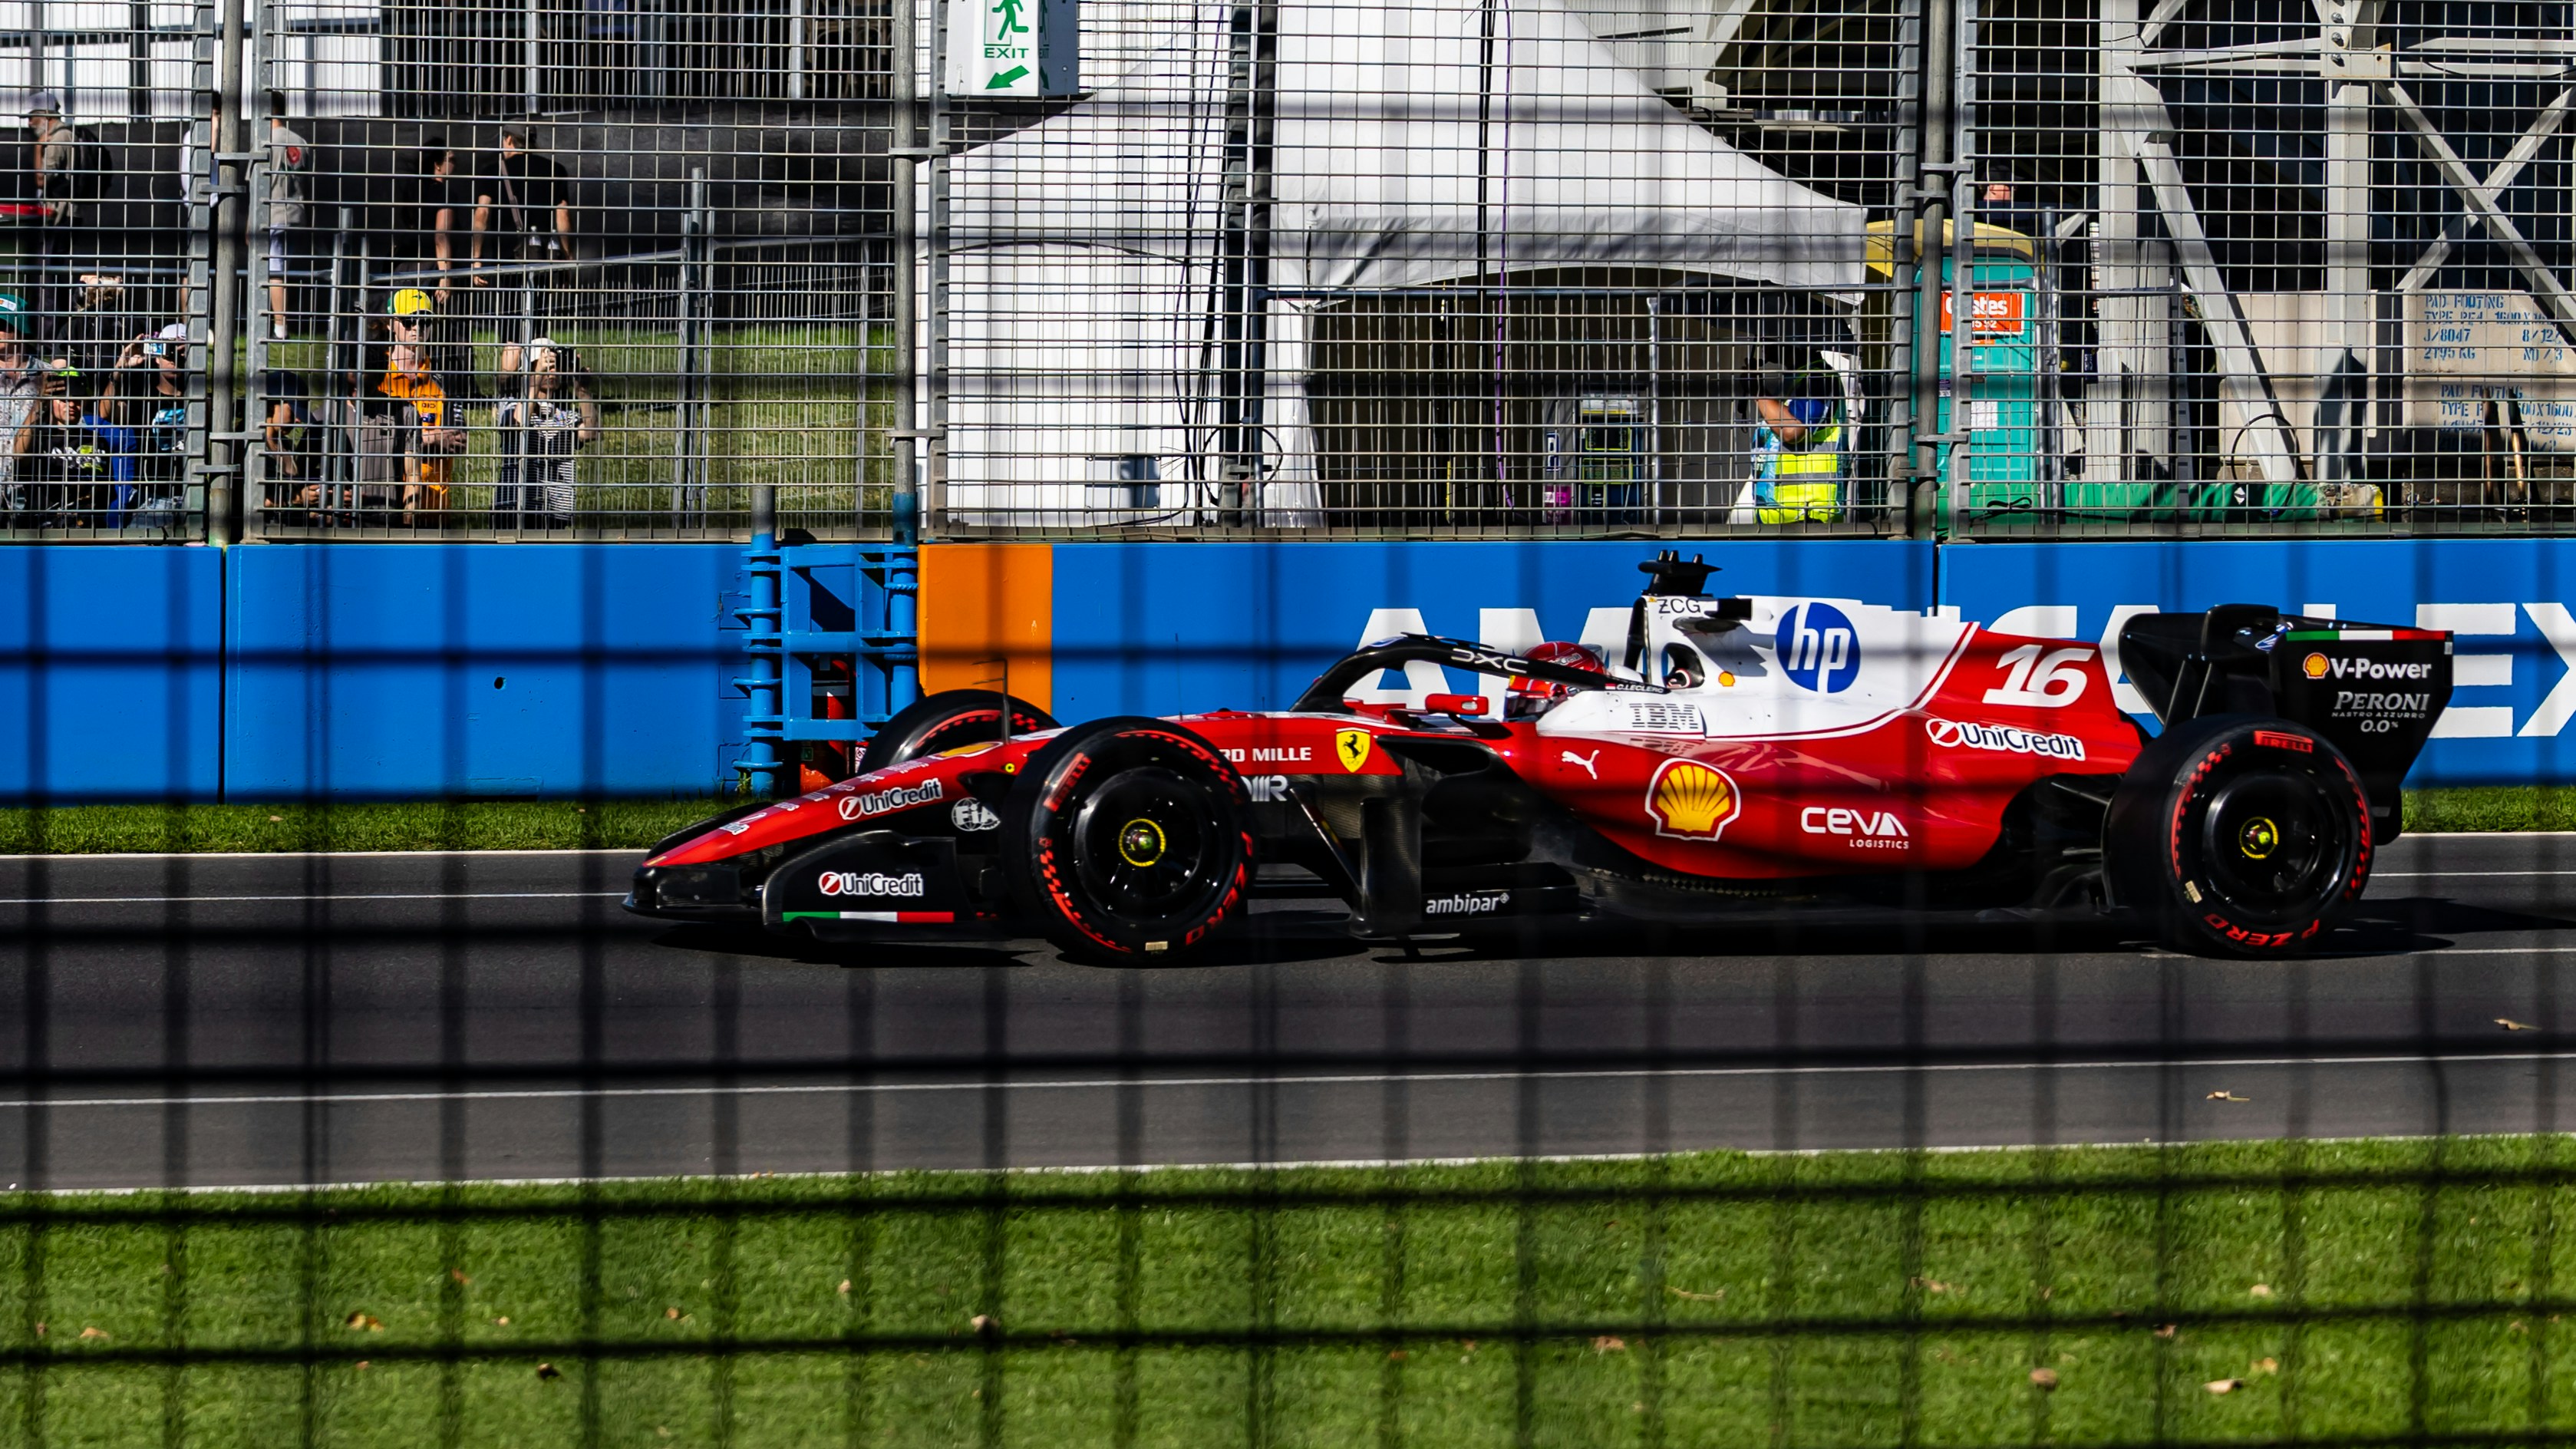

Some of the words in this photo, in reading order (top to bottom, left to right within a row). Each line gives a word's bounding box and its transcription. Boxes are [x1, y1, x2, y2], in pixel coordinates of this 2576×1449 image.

[984, 48, 1030, 58] EXIT
[2442, 402, 2469, 417] TYPE
[1657, 599, 1701, 614] ZCG
[1788, 602, 1851, 694] hp
[1982, 644, 2096, 708] 16
[2330, 658, 2432, 679] V-Power
[2334, 691, 2431, 711] PERONI
[1628, 703, 1699, 730] IBM
[1959, 723, 2084, 760] UniCredit
[1252, 747, 1312, 761] MILLE
[860, 778, 943, 814] UniCredit
[1849, 839, 1909, 850] LOGISTICS
[842, 873, 923, 896] UniCredit
[1426, 893, 1499, 915] ambipar
[2204, 913, 2294, 947] ZERO
